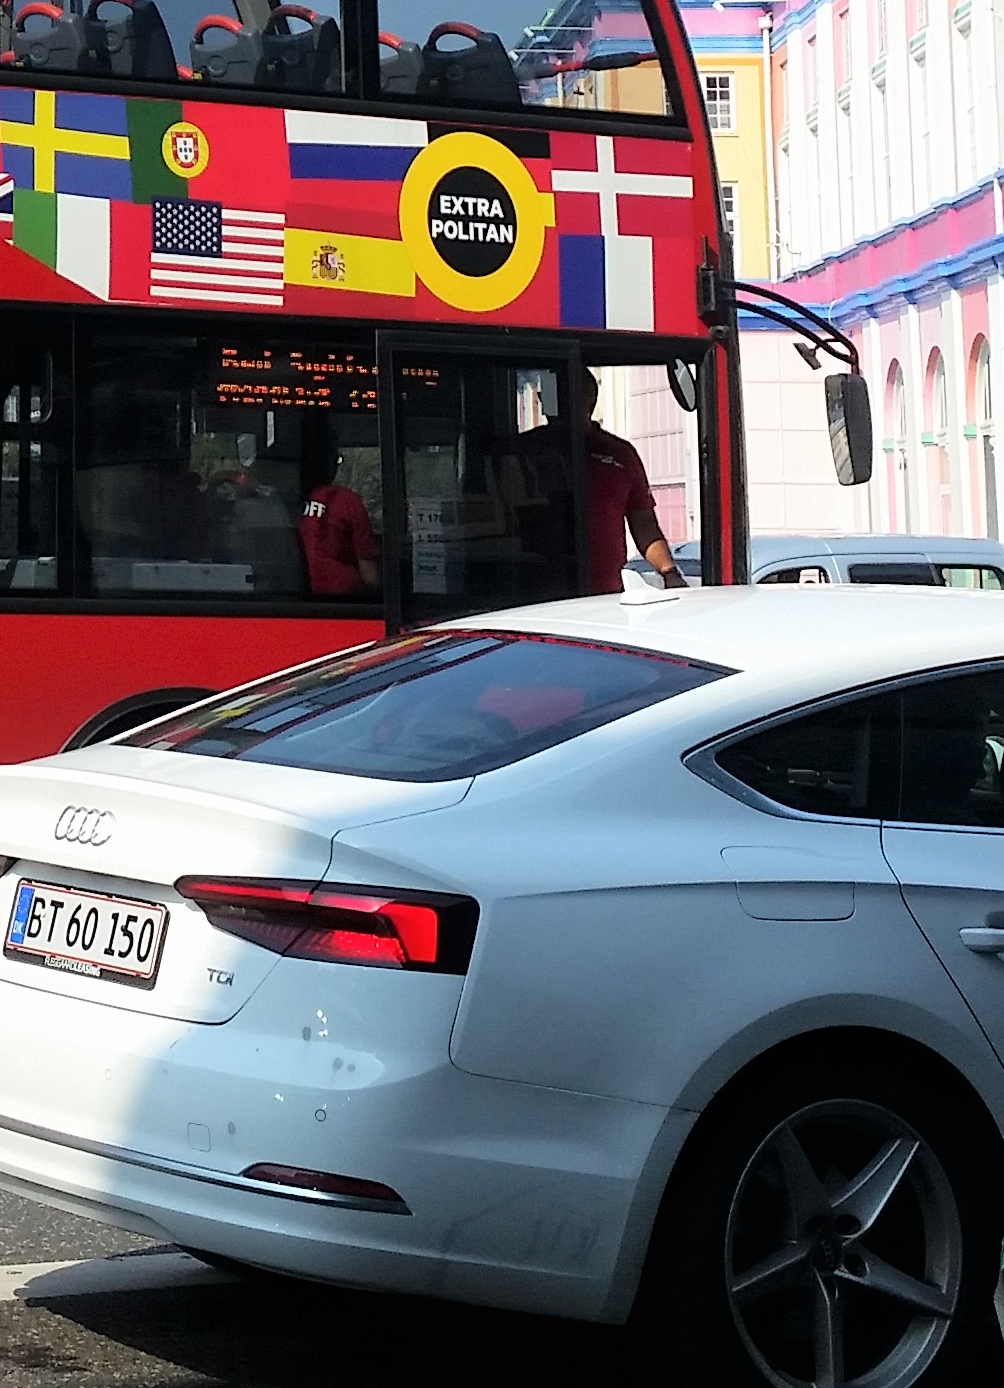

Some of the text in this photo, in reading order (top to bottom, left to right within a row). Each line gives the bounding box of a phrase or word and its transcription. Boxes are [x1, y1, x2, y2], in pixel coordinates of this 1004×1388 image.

[440, 195, 505, 218] EXTRA
[431, 219, 514, 244] POLITAN
[26, 897, 155, 963] BT 60 150
